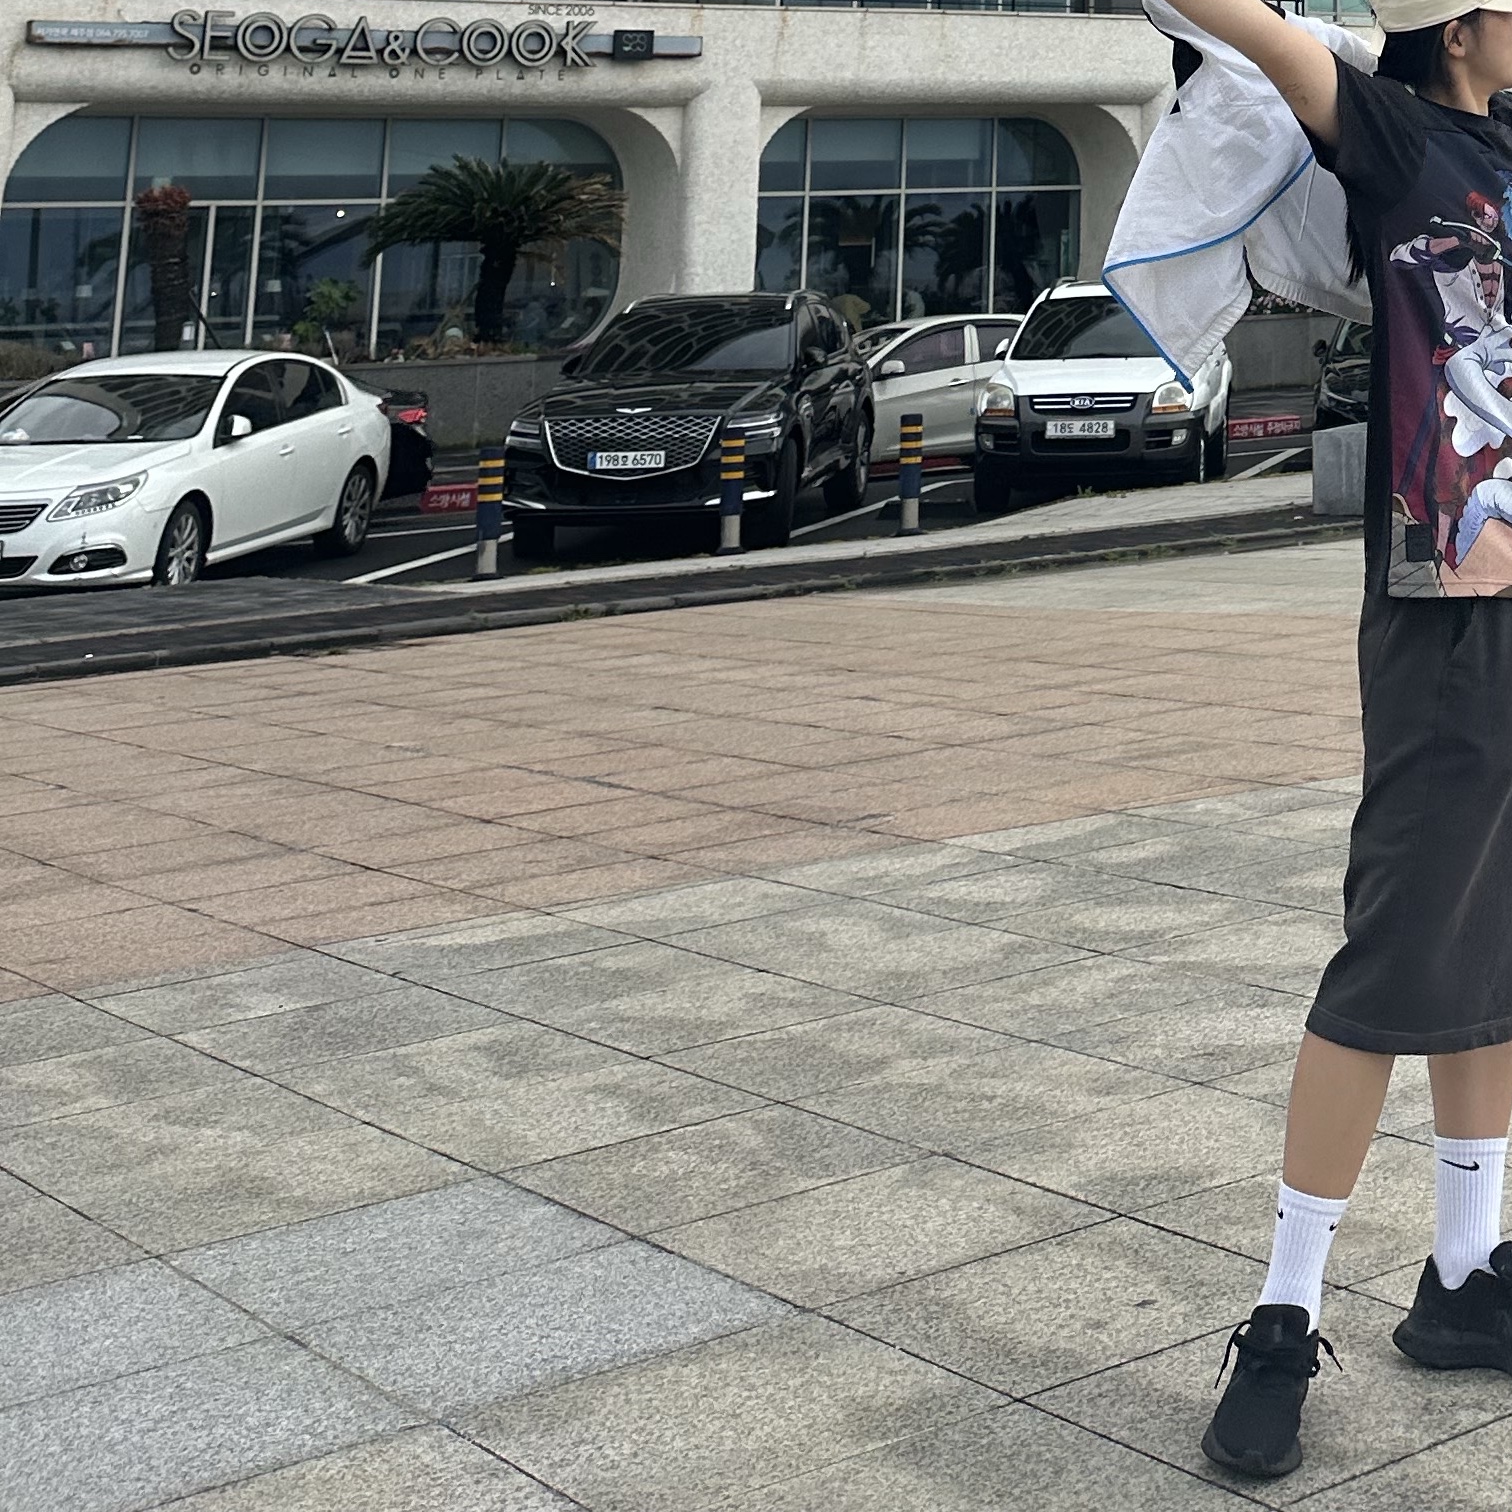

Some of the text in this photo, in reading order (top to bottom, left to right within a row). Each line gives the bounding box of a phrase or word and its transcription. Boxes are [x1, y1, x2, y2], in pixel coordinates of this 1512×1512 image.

[528, 4, 595, 16] SINCE 2006
[165, 8, 598, 68] SEOGA&COOK
[189, 63, 566, 81] ORIGINAL ONE PLATE
[1079, 421, 1109, 433] 4828
[631, 453, 662, 467] 6570
